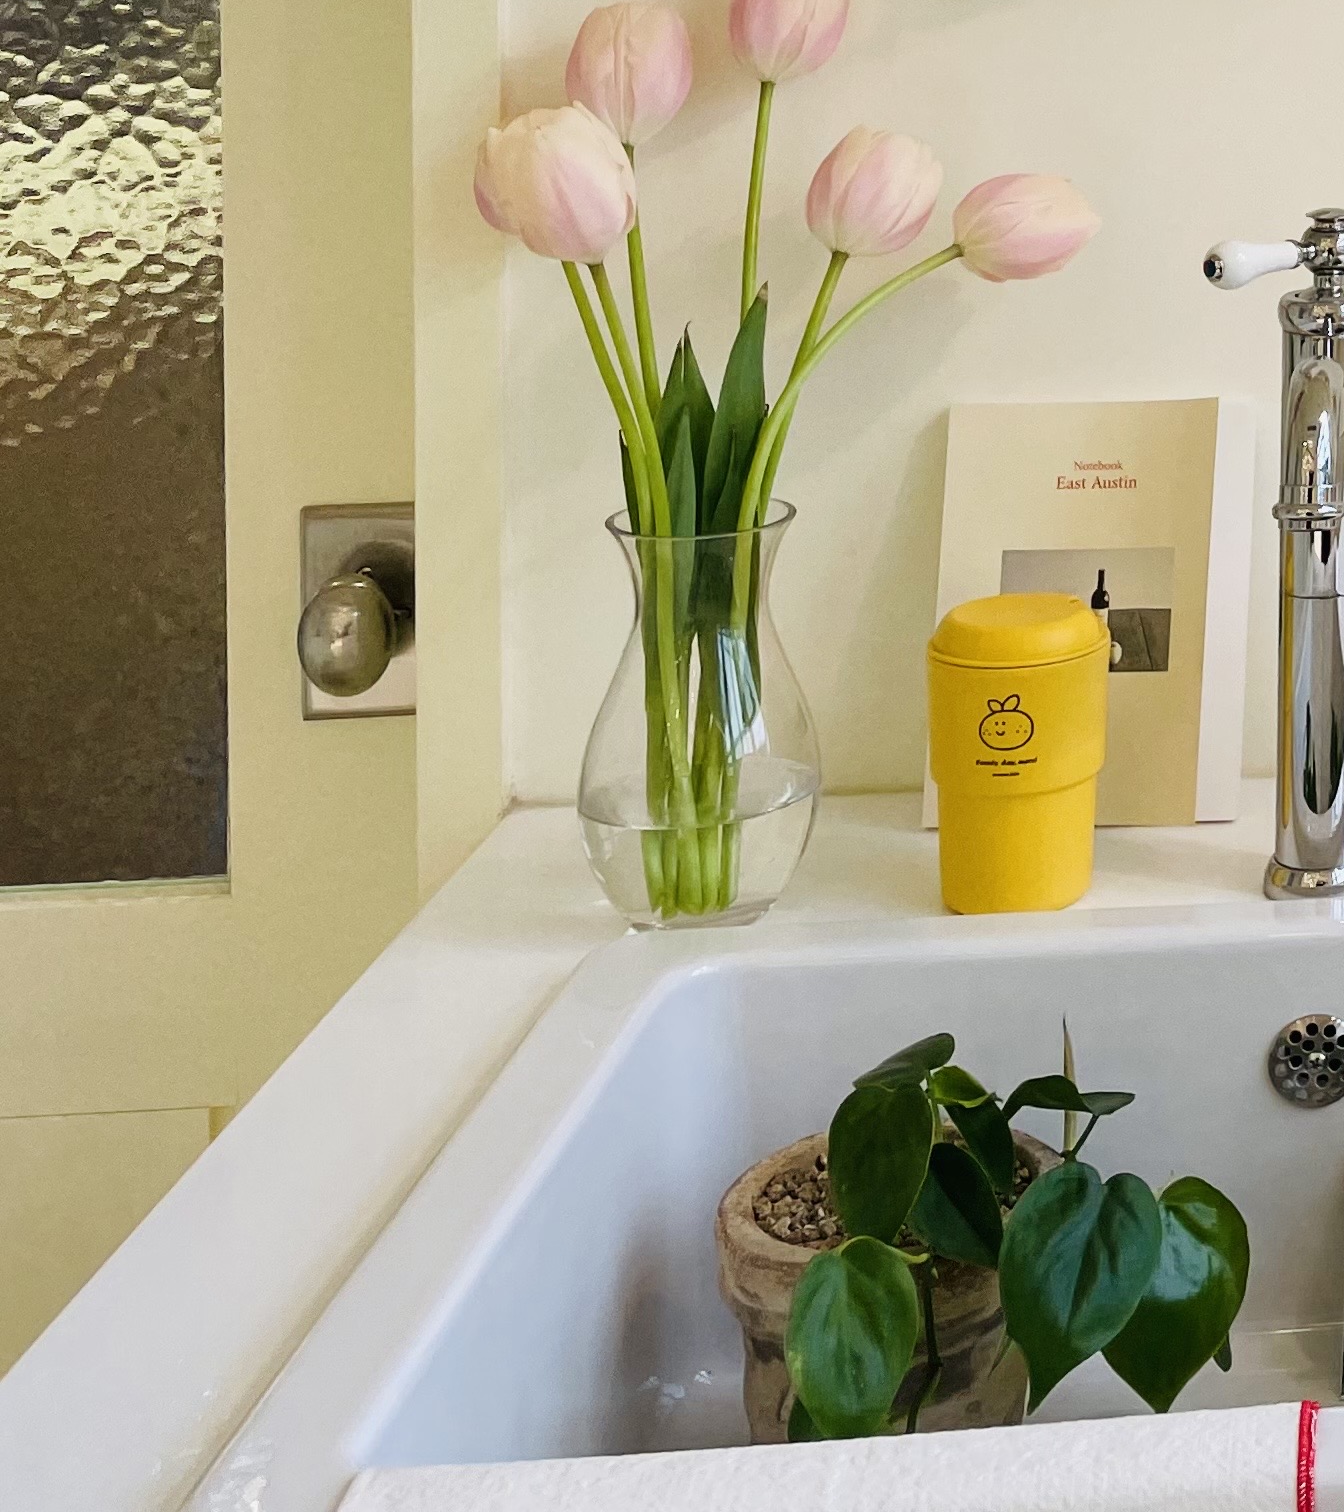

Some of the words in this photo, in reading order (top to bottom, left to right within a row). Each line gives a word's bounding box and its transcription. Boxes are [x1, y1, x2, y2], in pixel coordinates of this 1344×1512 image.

[1073, 460, 1124, 472] Notebook
[1056, 475, 1086, 491] East
[1091, 474, 1138, 491] Austin
